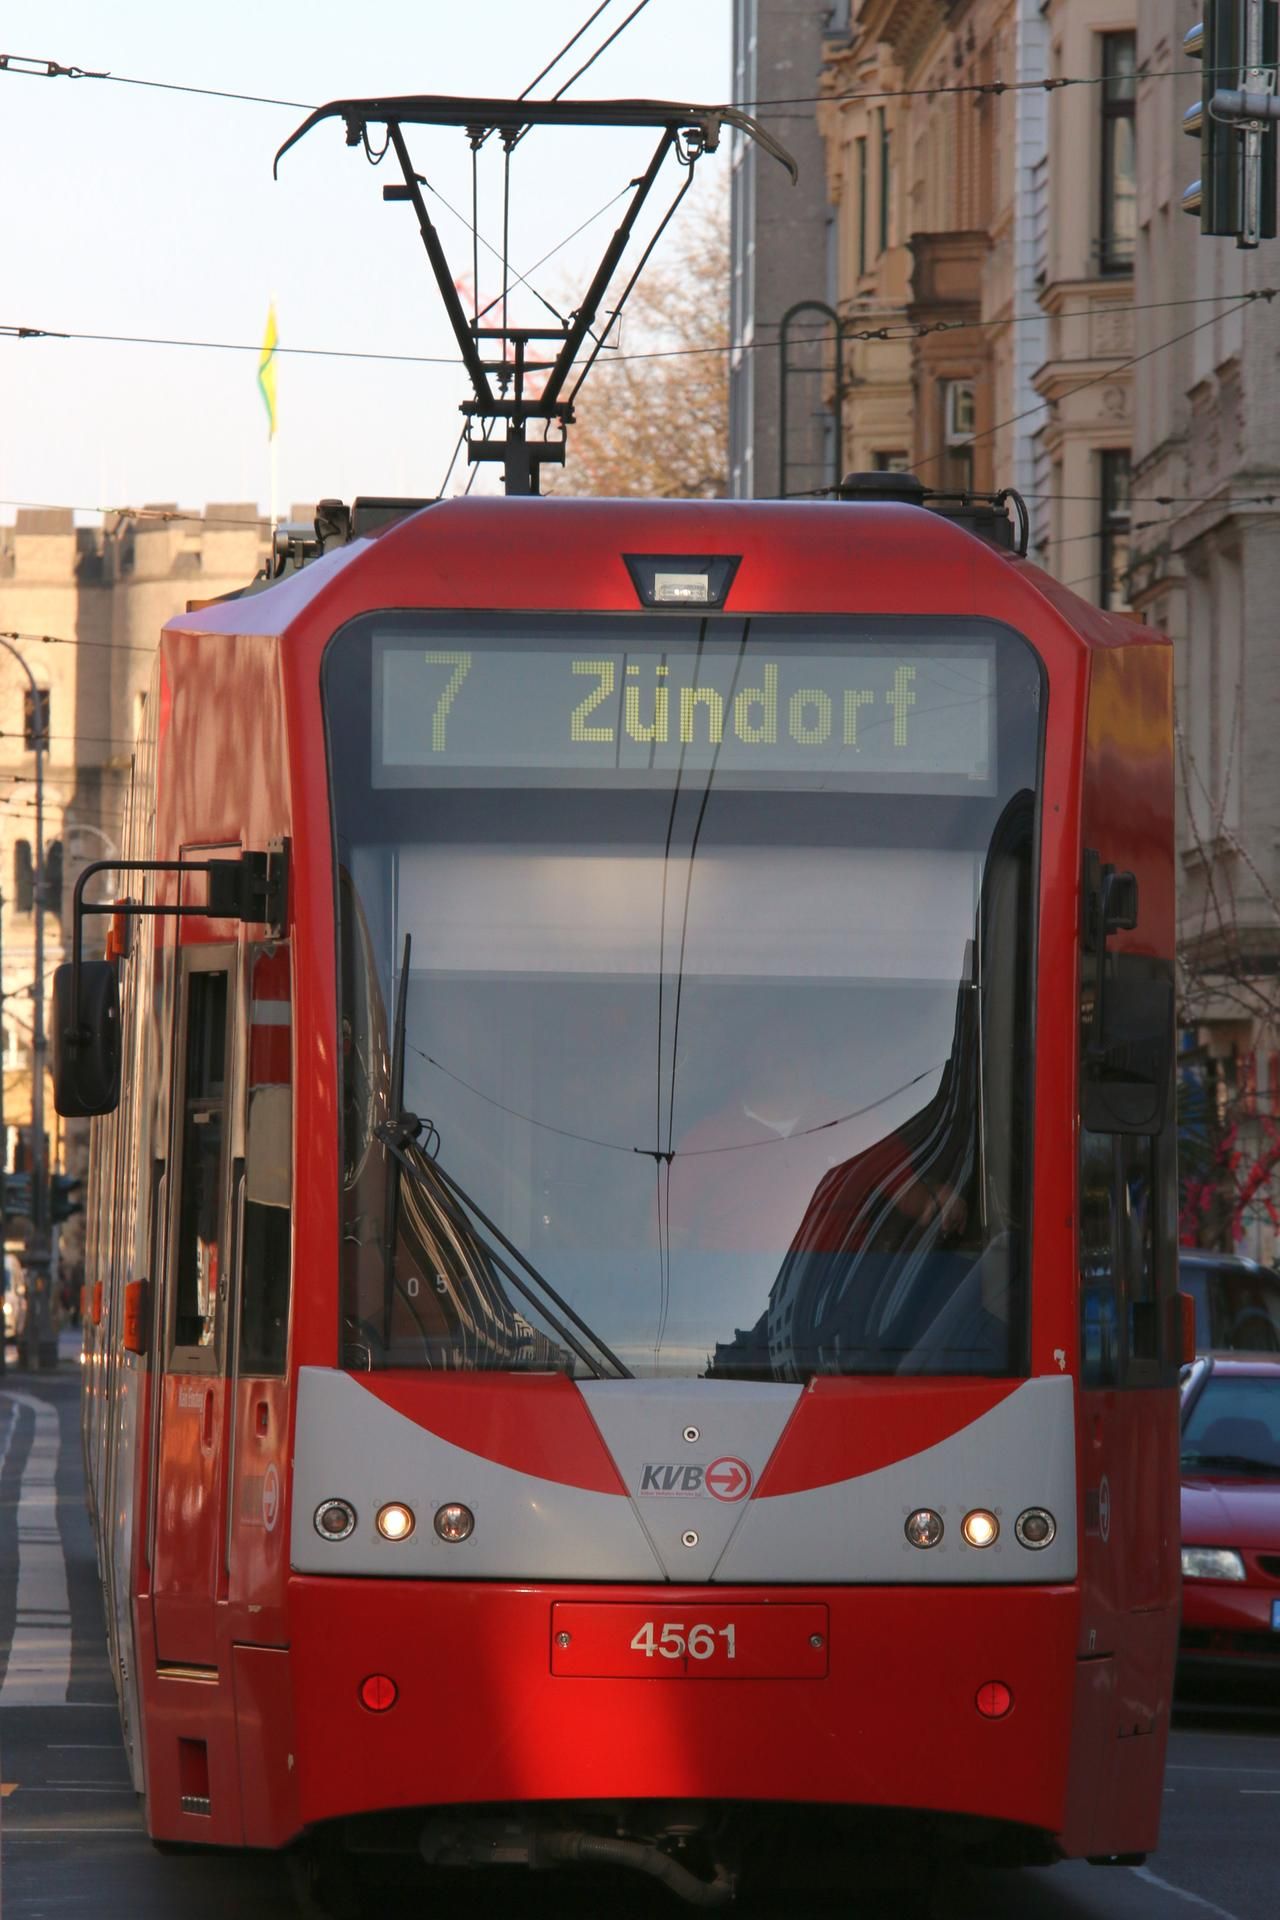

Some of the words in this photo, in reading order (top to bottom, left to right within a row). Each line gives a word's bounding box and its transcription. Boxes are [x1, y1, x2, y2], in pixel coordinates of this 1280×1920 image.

[425, 651, 472, 752] 7
[571, 660, 917, 747] Zündorf
[641, 1465, 704, 1491] KVB
[630, 1622, 736, 1660] 4561
